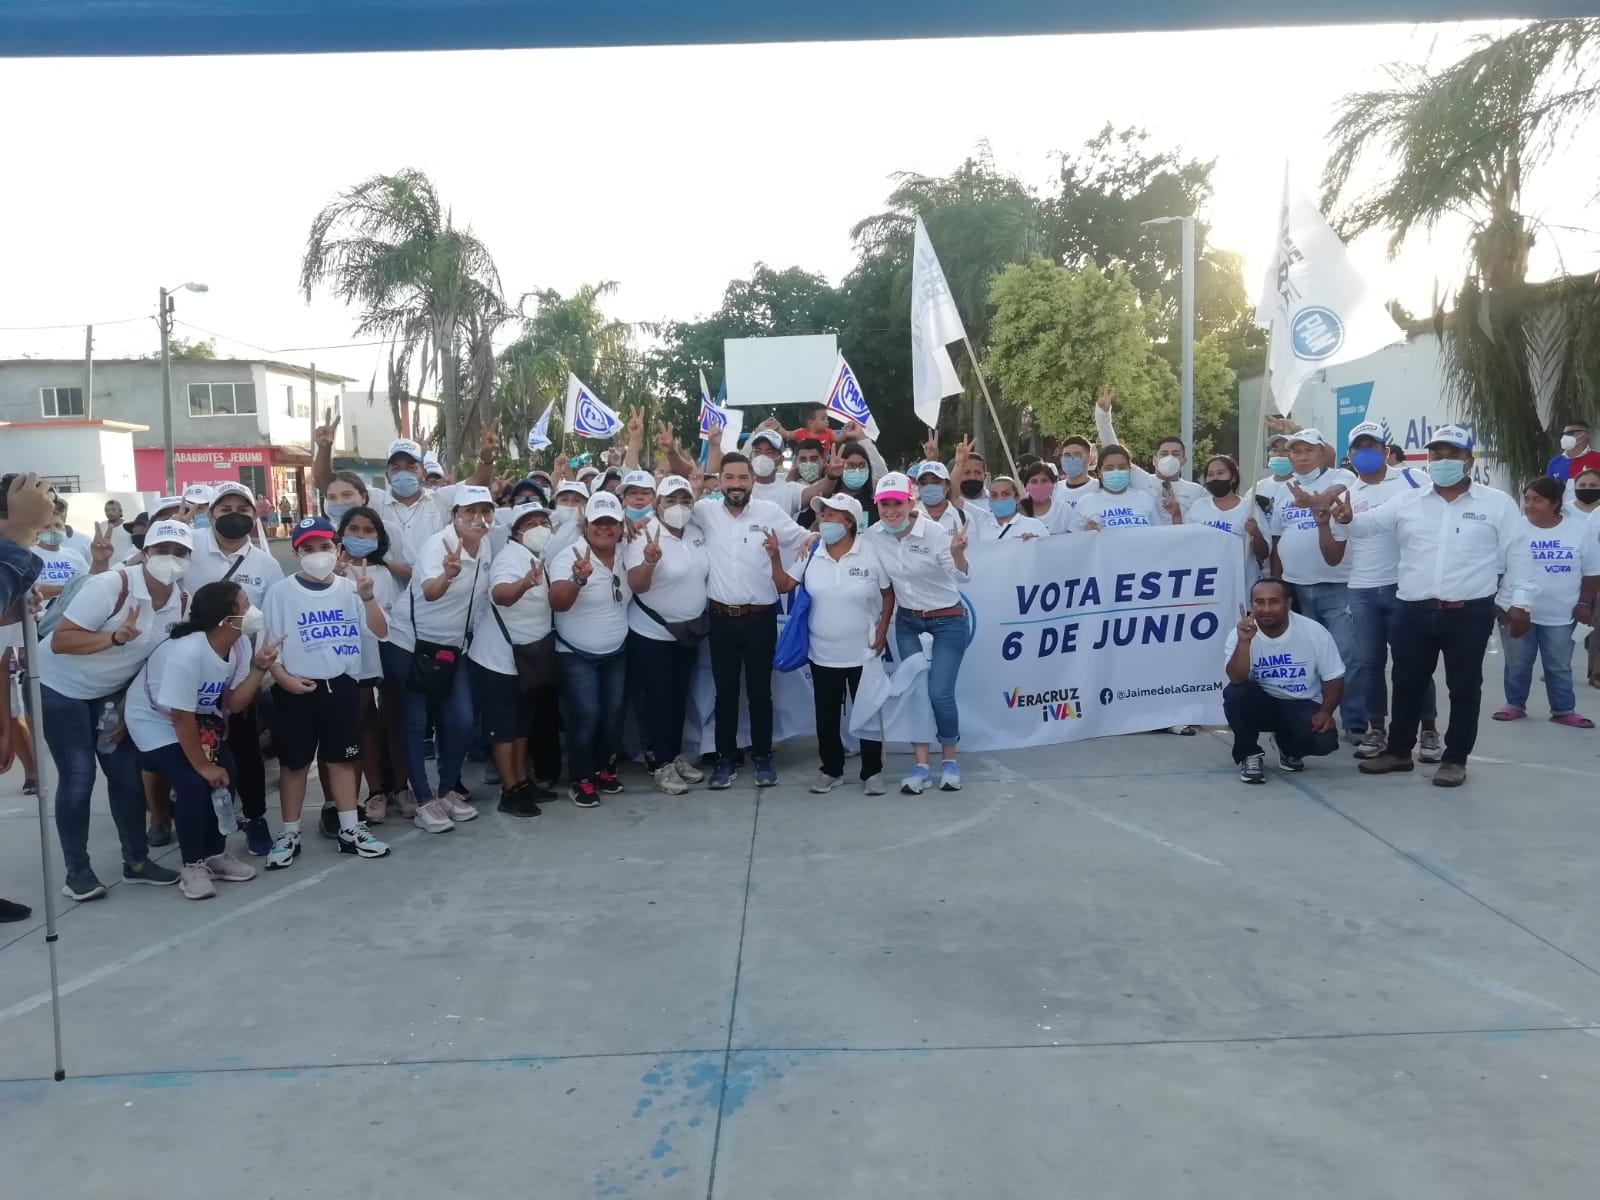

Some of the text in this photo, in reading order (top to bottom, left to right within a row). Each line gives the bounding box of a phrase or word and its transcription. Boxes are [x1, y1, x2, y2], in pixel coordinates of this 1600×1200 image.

[1295, 312, 1337, 354] PAN
[174, 452, 262, 462] ABARROTES JERUMI
[1101, 507, 1134, 518] JAIME
[1107, 517, 1149, 526] GARZA
[43, 561, 72, 570] AIME
[1016, 567, 1218, 615] VOTA ESTE
[297, 609, 345, 626] JAIME
[311, 625, 359, 639] GARZA
[1002, 611, 1219, 661] 6 DE JUNIO
[1253, 653, 1293, 668] JAIME
[1261, 667, 1307, 679] GARZA
